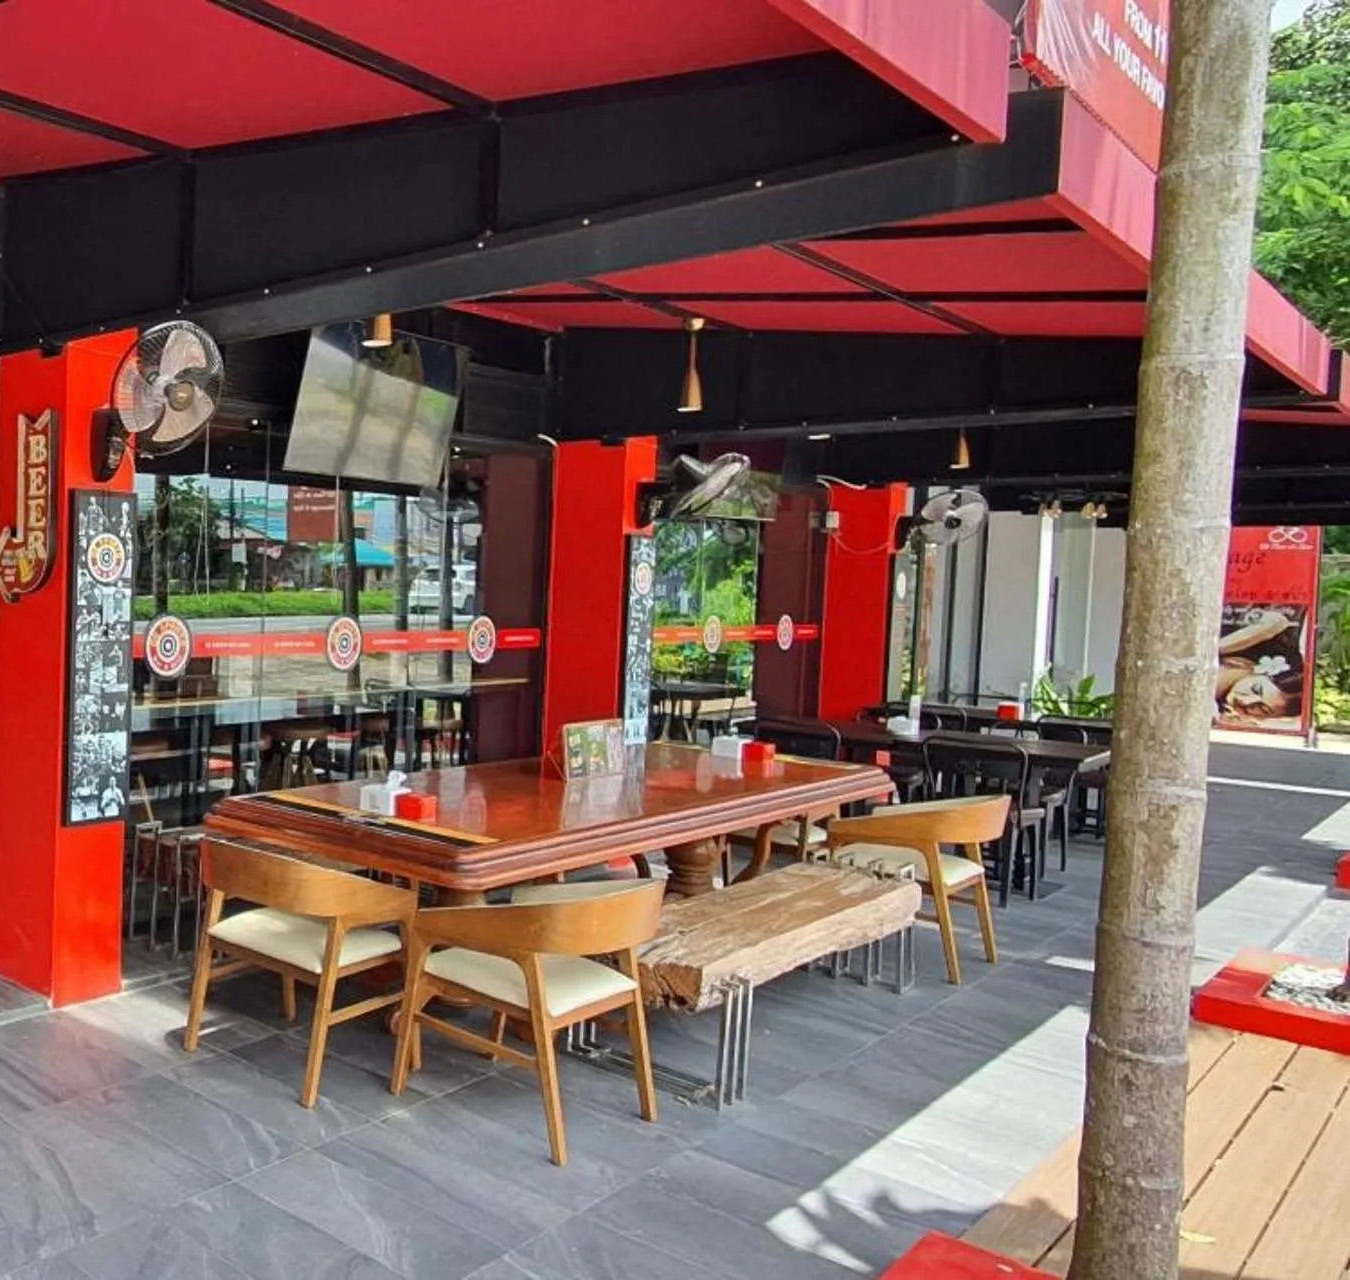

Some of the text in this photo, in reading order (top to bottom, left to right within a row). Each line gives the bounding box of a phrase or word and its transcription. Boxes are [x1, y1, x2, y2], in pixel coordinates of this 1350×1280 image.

[1091, 11, 1111, 57] ALL
[1113, 31, 1140, 88] YOUR
[1124, 0, 1153, 50] FROM
[27, 434, 48, 562] BEER
